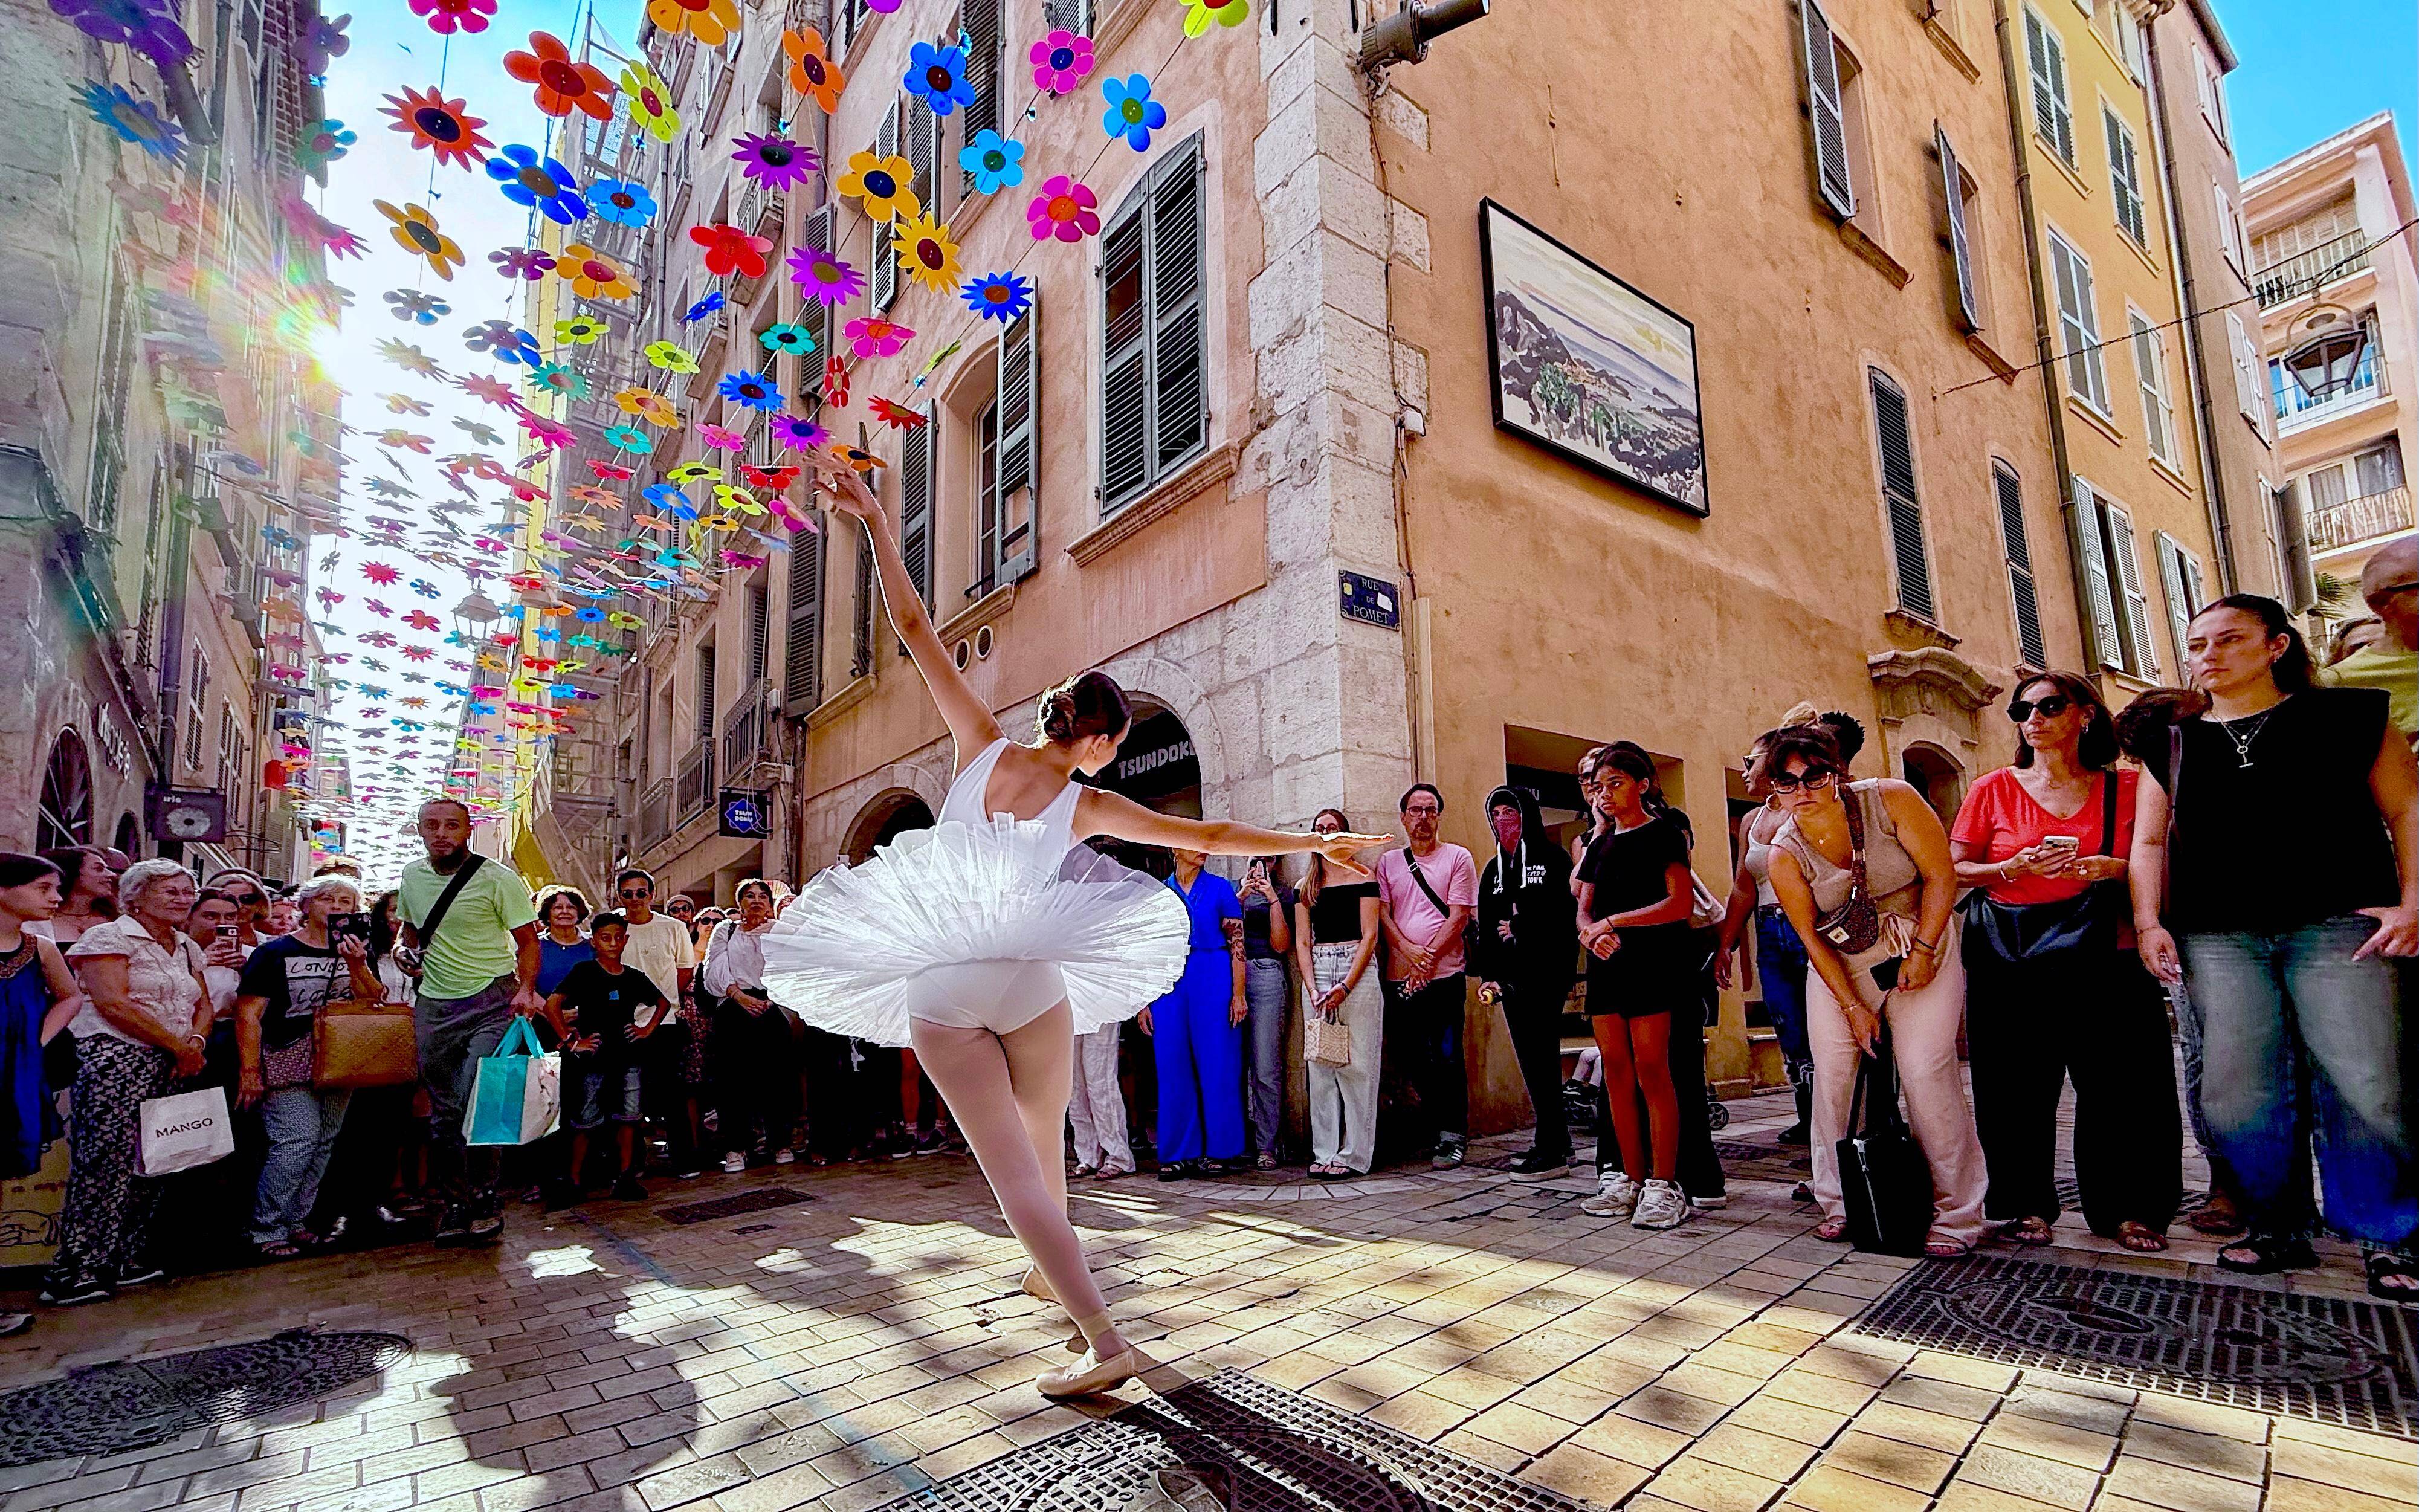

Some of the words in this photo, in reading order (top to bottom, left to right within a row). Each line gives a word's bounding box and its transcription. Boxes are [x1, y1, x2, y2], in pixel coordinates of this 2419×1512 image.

[1361, 577, 1380, 591] RUE
[1366, 595, 1375, 604] DE
[1353, 605, 1389, 624] POMET
[291, 962, 350, 974] LONDO
[155, 1117, 213, 1138] MANGO
